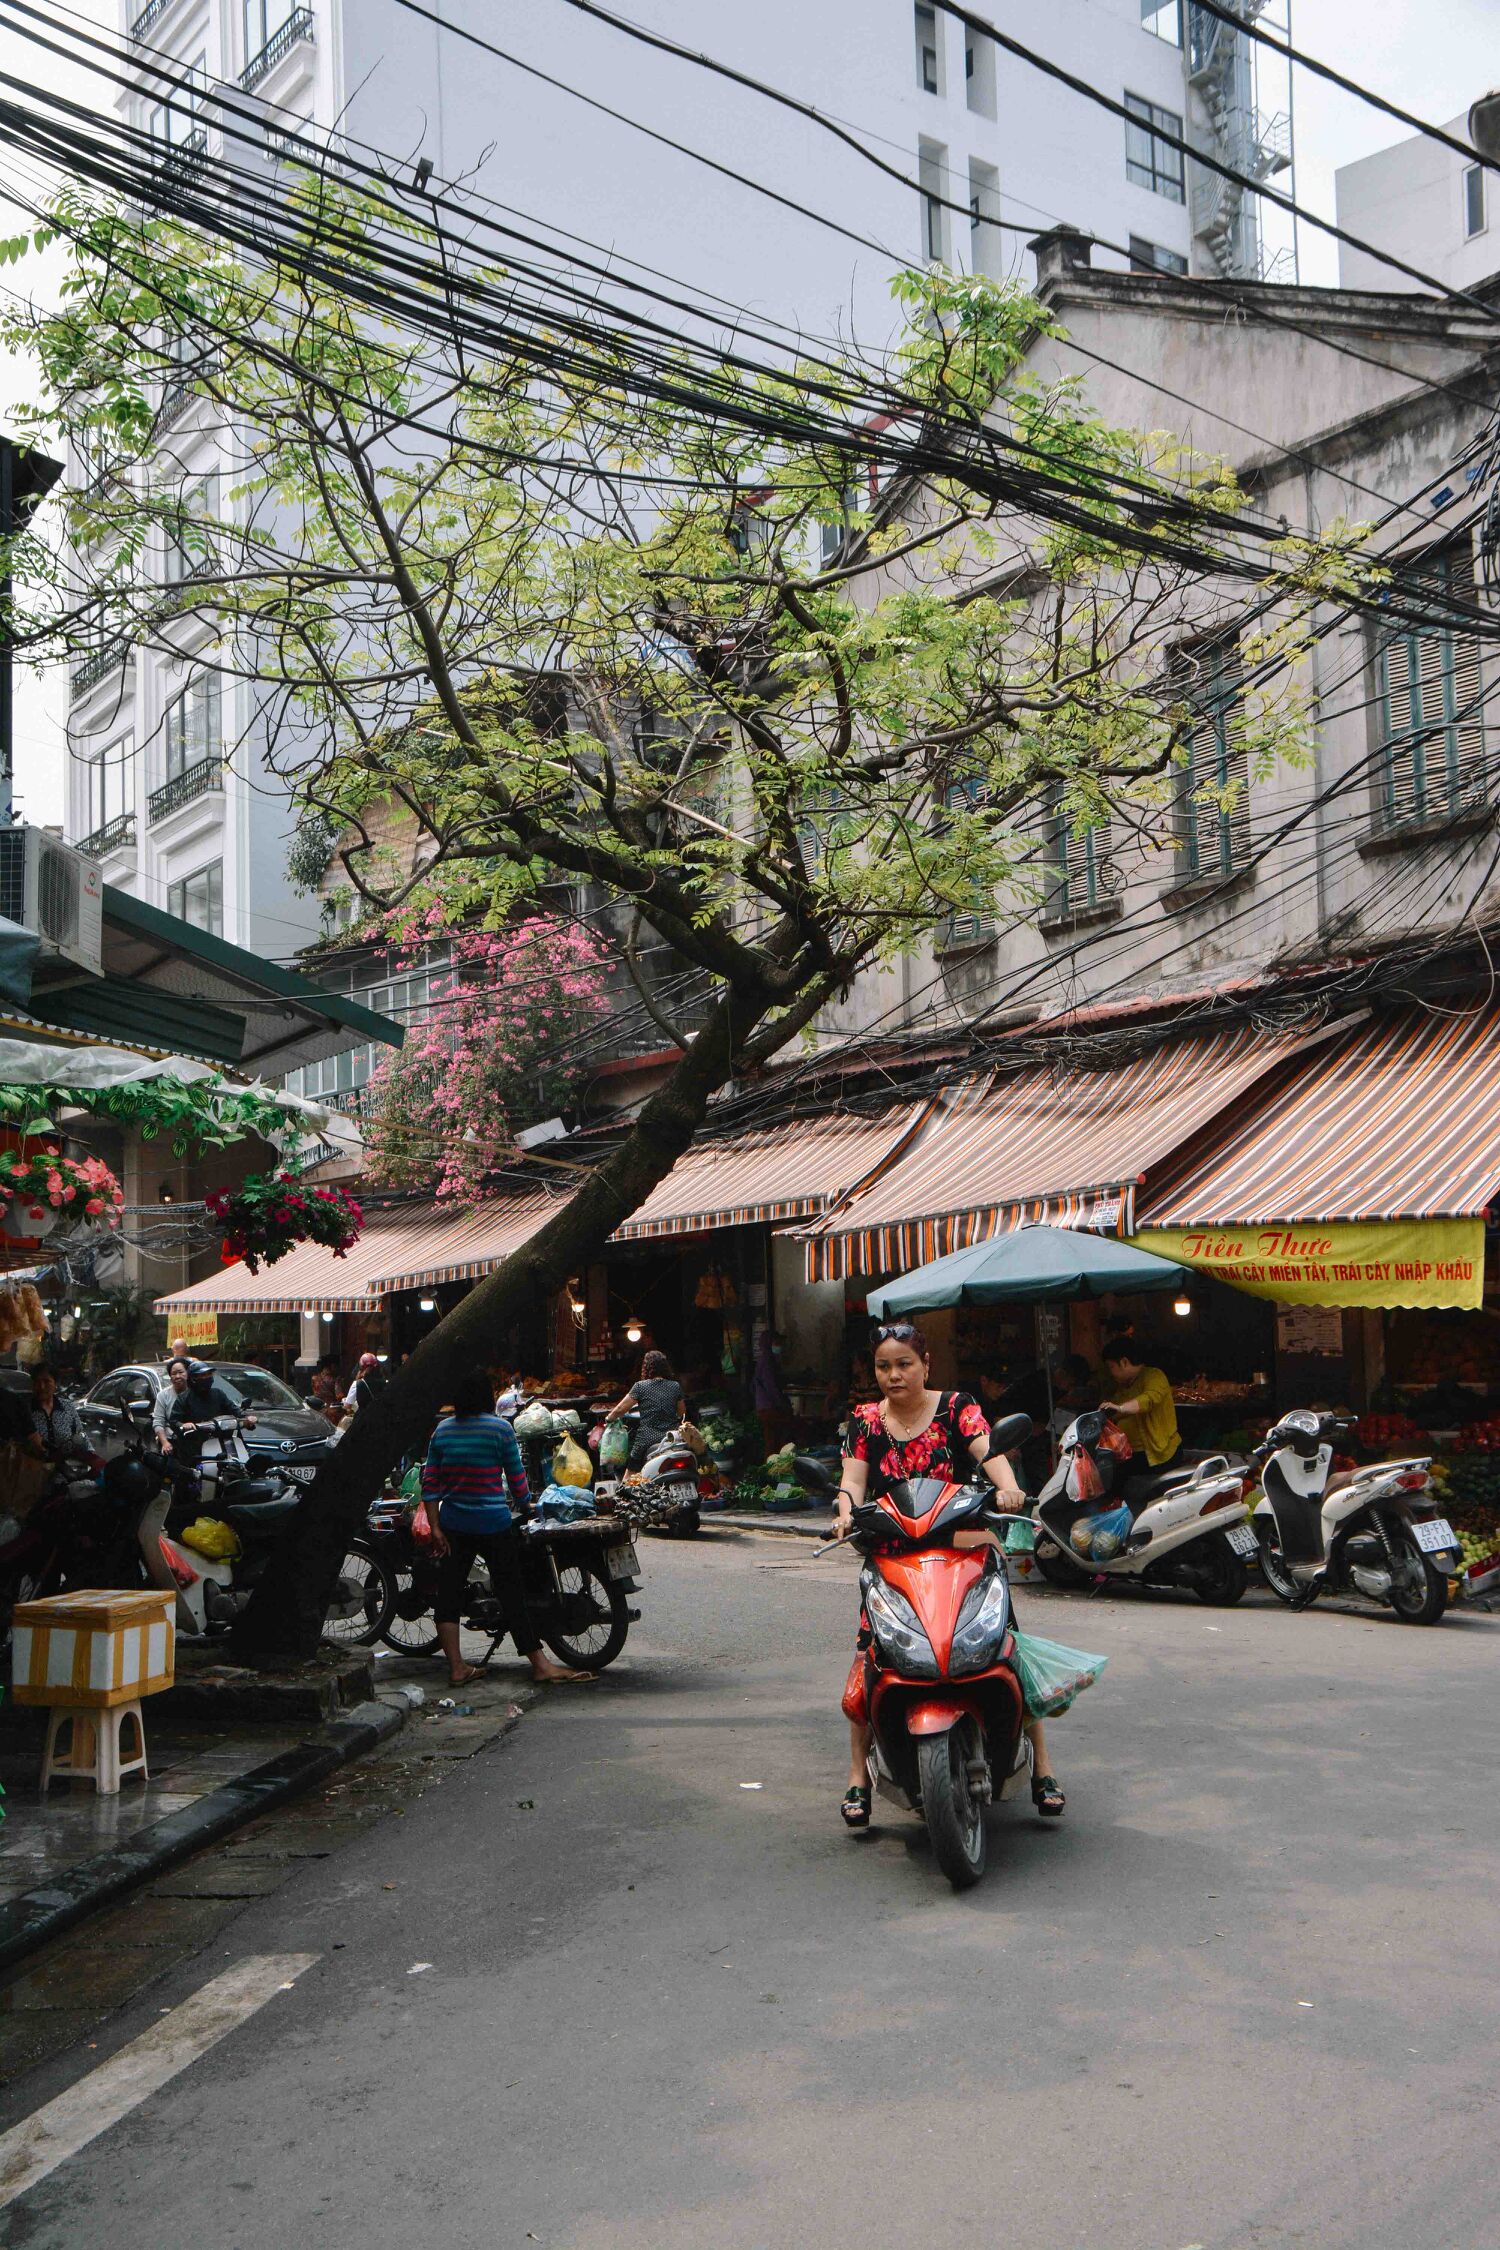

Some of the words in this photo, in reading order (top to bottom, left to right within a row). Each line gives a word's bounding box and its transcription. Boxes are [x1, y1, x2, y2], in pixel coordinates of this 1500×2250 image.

[1182, 1234, 1245, 1258] Tiền
[1258, 1232, 1332, 1260] Thực
[1243, 1263, 1265, 1281] CÂY
[1304, 1262, 1330, 1282] TÂY,
[1332, 1261, 1361, 1281] TRÁI
[1365, 1261, 1390, 1281] CÂY
[1394, 1260, 1432, 1284] NHẬP
